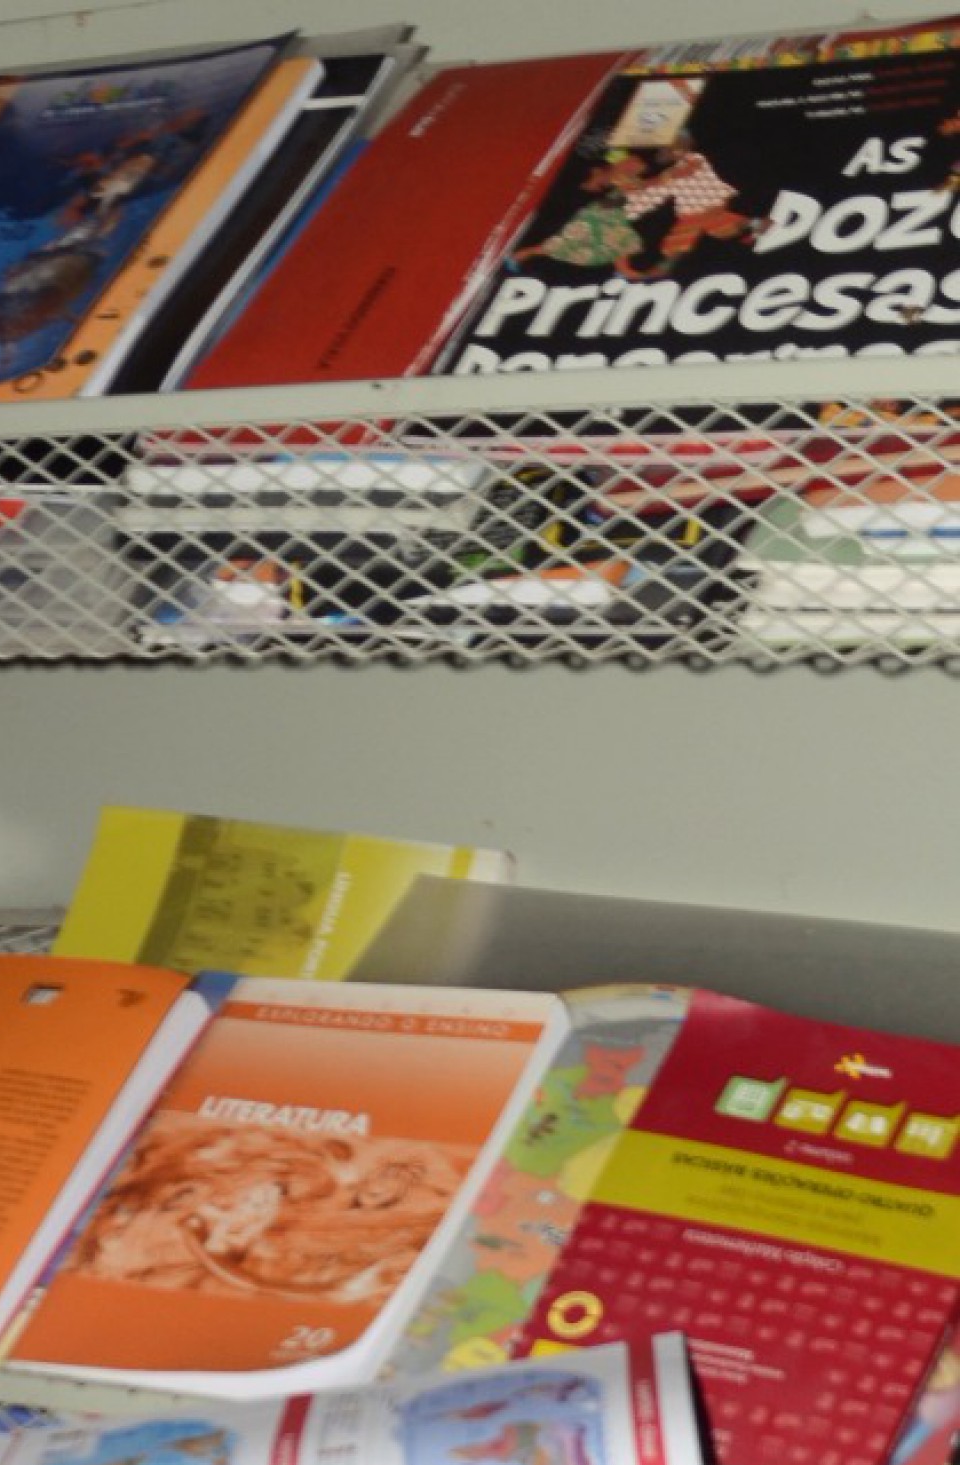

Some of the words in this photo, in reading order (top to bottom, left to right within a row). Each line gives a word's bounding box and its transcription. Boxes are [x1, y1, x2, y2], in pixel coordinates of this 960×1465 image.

[841, 136, 927, 176] AS
[753, 189, 960, 254] DOZ
[474, 268, 960, 337] Princesa
[197, 1095, 371, 1136] LITERATURA
